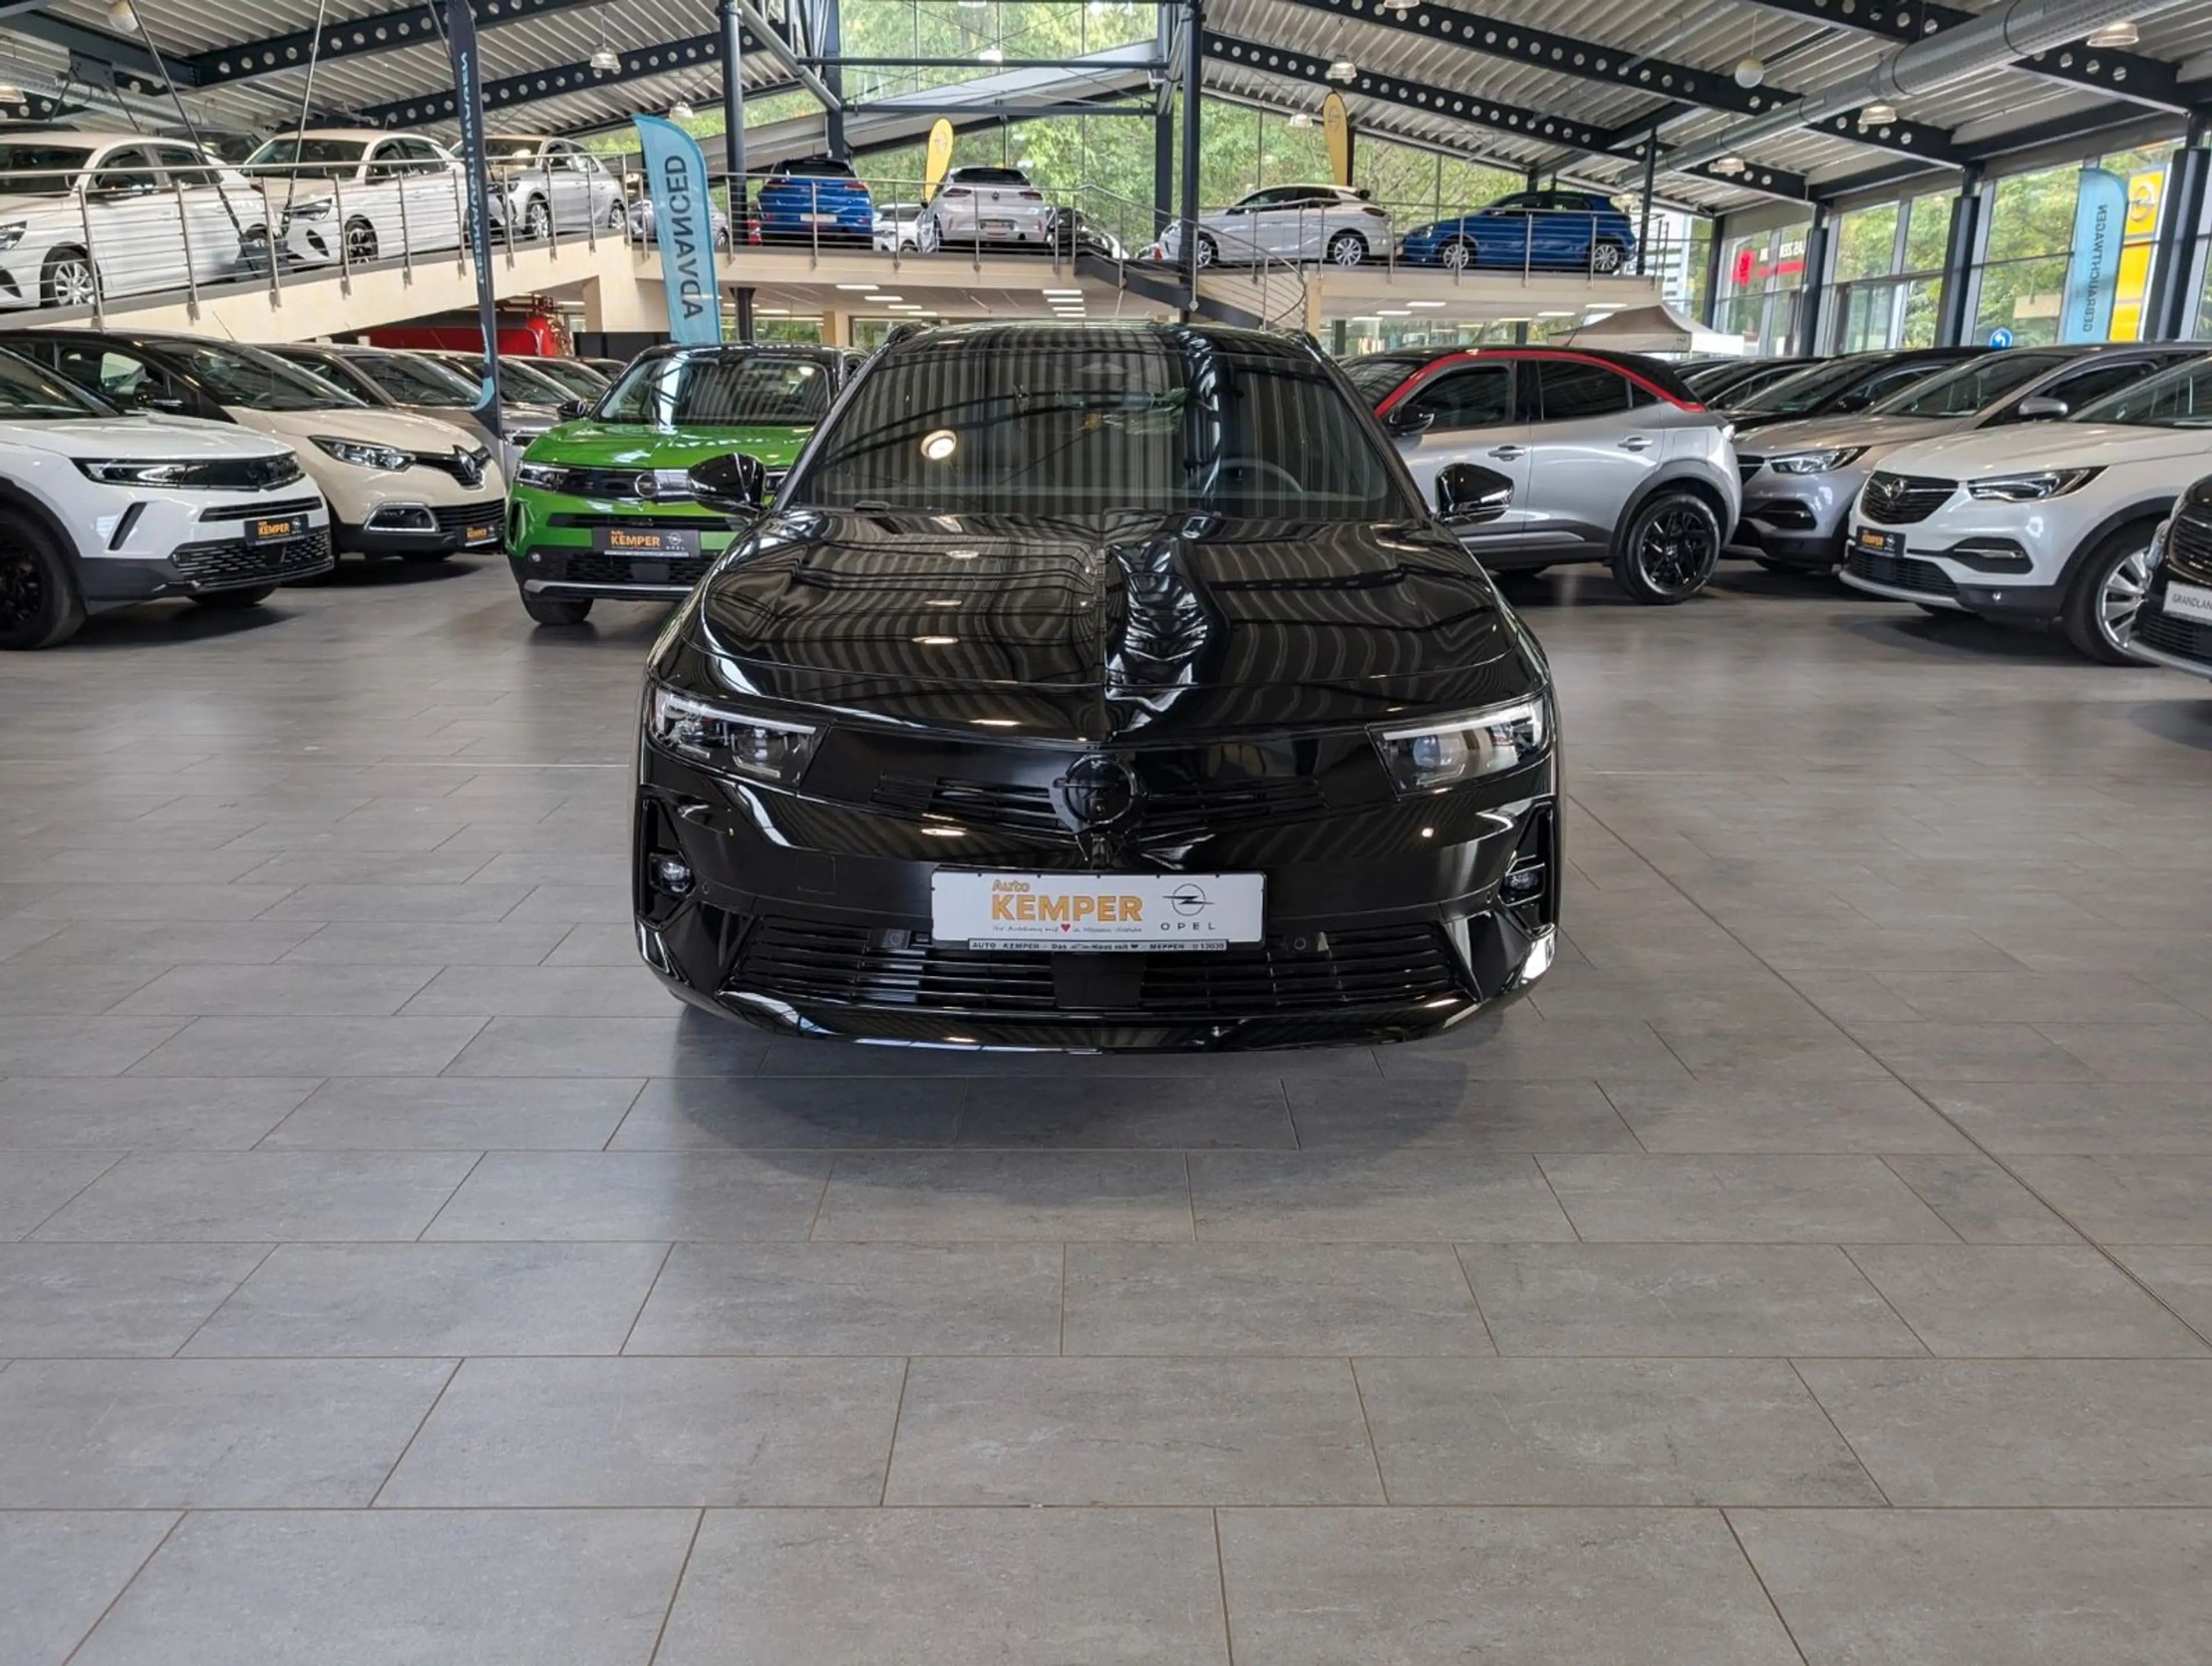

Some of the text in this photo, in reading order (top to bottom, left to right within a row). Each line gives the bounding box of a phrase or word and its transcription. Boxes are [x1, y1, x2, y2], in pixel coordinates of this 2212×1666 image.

[610, 535, 660, 547] KEMPER
[992, 879, 1030, 892] Auto
[992, 894, 1143, 922] KEMPER
[1160, 922, 1216, 931] OPEL
